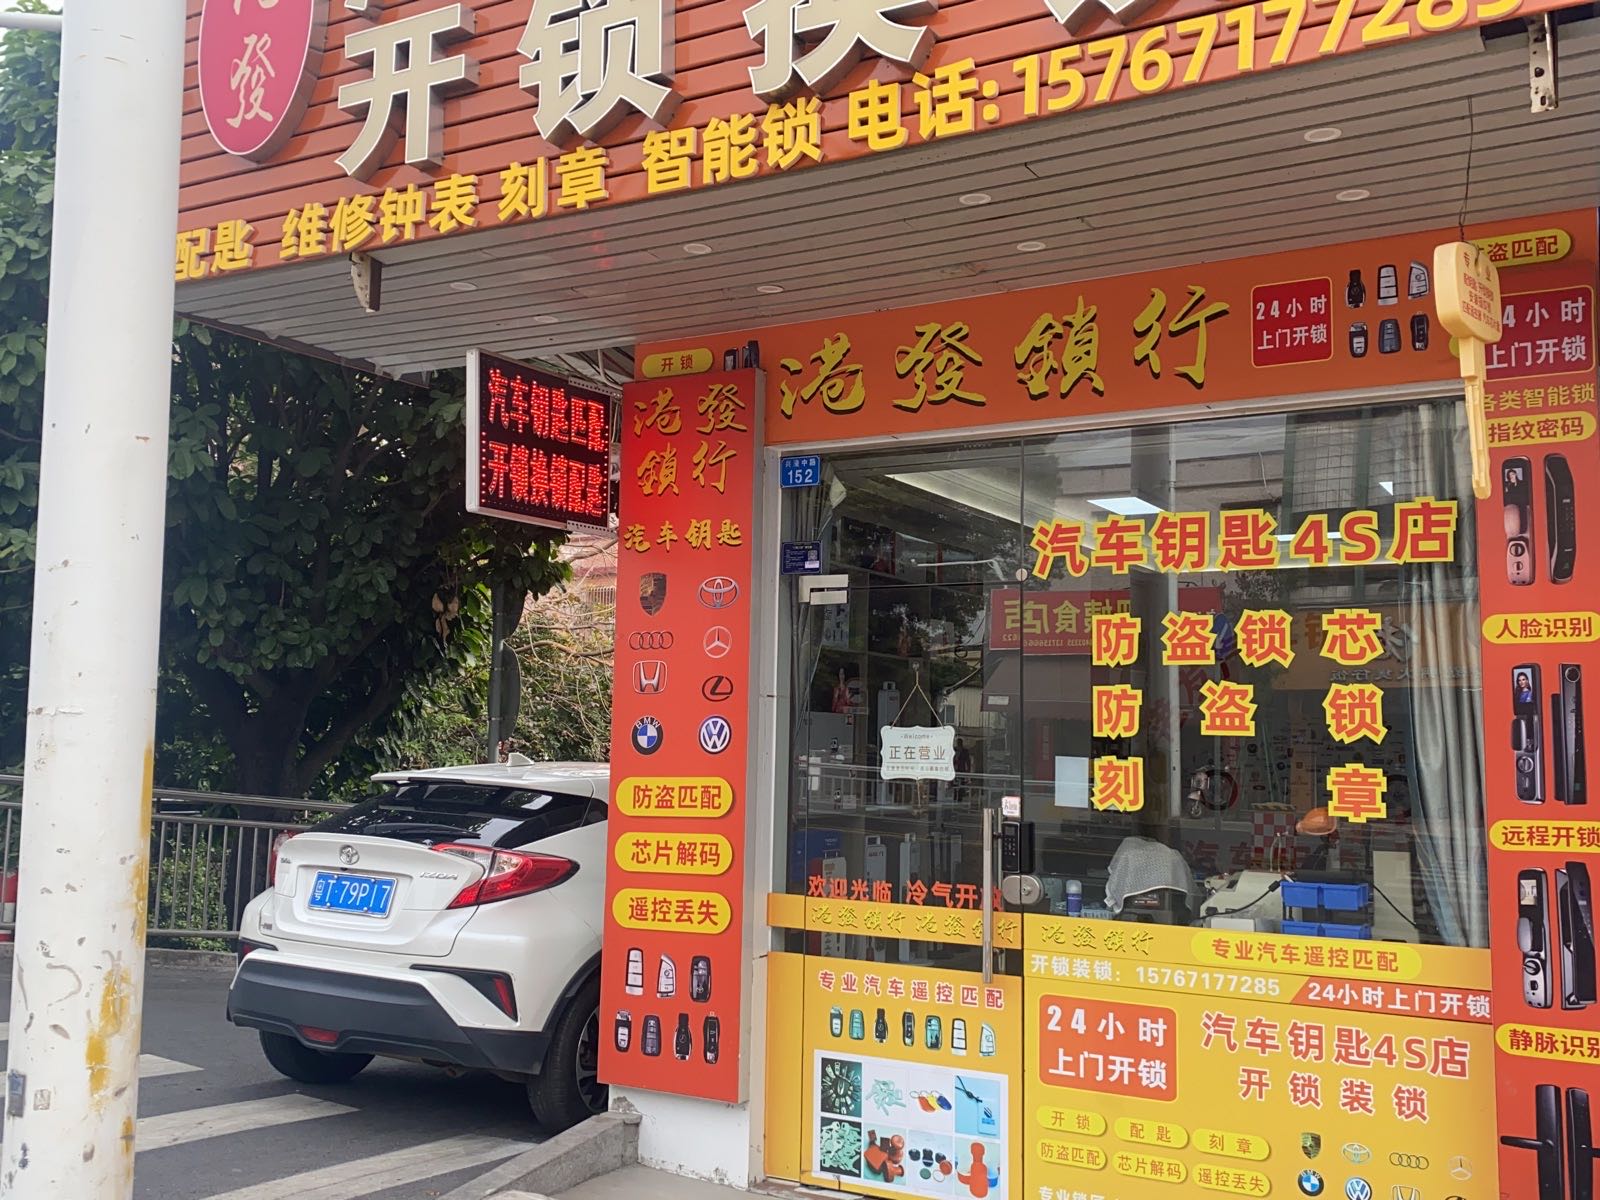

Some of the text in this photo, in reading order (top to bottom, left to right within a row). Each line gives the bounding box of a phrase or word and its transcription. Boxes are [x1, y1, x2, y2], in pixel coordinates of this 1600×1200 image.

[226, 0, 279, 128] 發
[175, 219, 254, 281] 配匙
[279, 174, 479, 260] 维修钟表
[497, 146, 609, 221] 刻章
[642, 97, 825, 194] 智能锁
[1478, 235, 1558, 262] 盗匹配
[1256, 294, 1327, 320] 24小时
[1503, 297, 1586, 327] 4小时
[1257, 323, 1328, 350] 上门开锁
[1486, 335, 1586, 369] 上门开锁
[661, 355, 693, 372] 开锁
[1484, 383, 1595, 412] 各类智能锁
[1488, 416, 1584, 443] 指纹密码
[787, 469, 813, 484] 152
[624, 519, 743, 553] 汽车钥匙
[1031, 496, 1457, 580] 汽车钥匙4S店
[1091, 608, 1385, 667] 防盗锁芯
[1495, 617, 1592, 639] 人脸识别
[1092, 681, 1388, 744] 防盗锁
[889, 745, 946, 760] 正在营业
[632, 785, 722, 809] 防盗匹配
[1091, 755, 1388, 824] 刻章
[631, 840, 720, 867] 芯片解码
[1501, 825, 1600, 848] 远程开锁
[808, 874, 893, 902] 欢迎光临
[628, 896, 719, 926] 遥控丢失
[1211, 937, 1399, 973] 专业汽车遥控匹配
[818, 969, 1005, 1011] 专业汽车遥控匹配
[1136, 966, 1280, 996] 15767177285
[1308, 982, 1491, 1018] 24小时上门开锁
[1047, 1005, 1168, 1047] 24小时
[1201, 1011, 1471, 1080] 汽车钥匙4S店
[1048, 1048, 1168, 1090] 上门开锁
[1238, 1066, 1429, 1123] 开锁装锁
[1051, 1110, 1252, 1155] 开锁 配匙 刻章
[1041, 1142, 1264, 1193] 防盗匹配 芯片解码 遥控丢失
